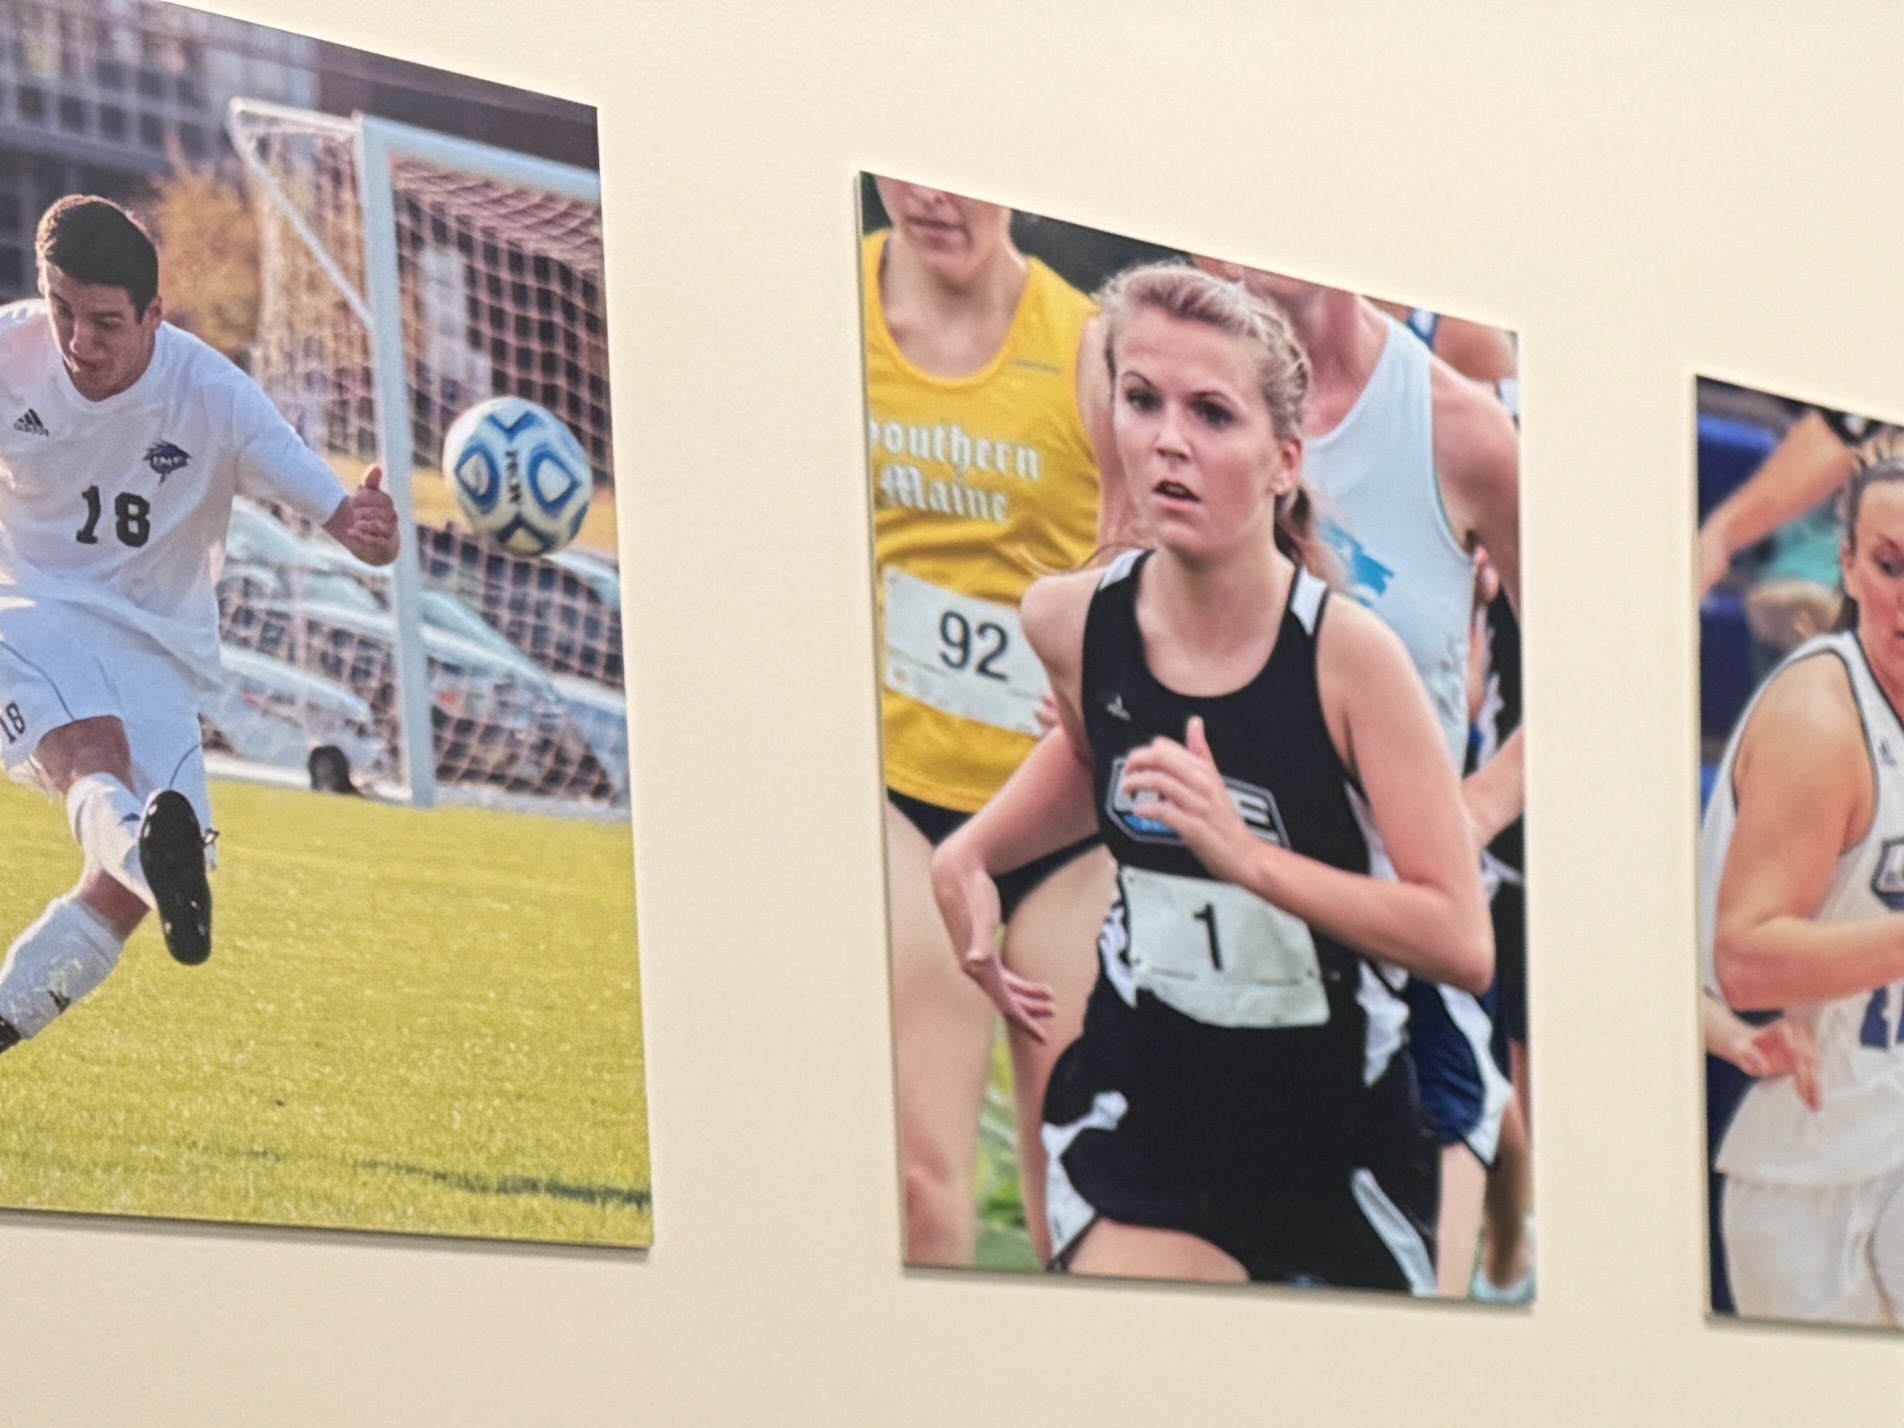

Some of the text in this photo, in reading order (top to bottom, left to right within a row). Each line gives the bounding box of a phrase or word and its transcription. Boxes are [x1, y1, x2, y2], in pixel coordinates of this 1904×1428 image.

[76, 484, 150, 548] 18
[880, 463, 1008, 524] Maine
[938, 610, 1009, 682] 92
[0, 702, 25, 744] 18
[1193, 903, 1223, 972] 1
